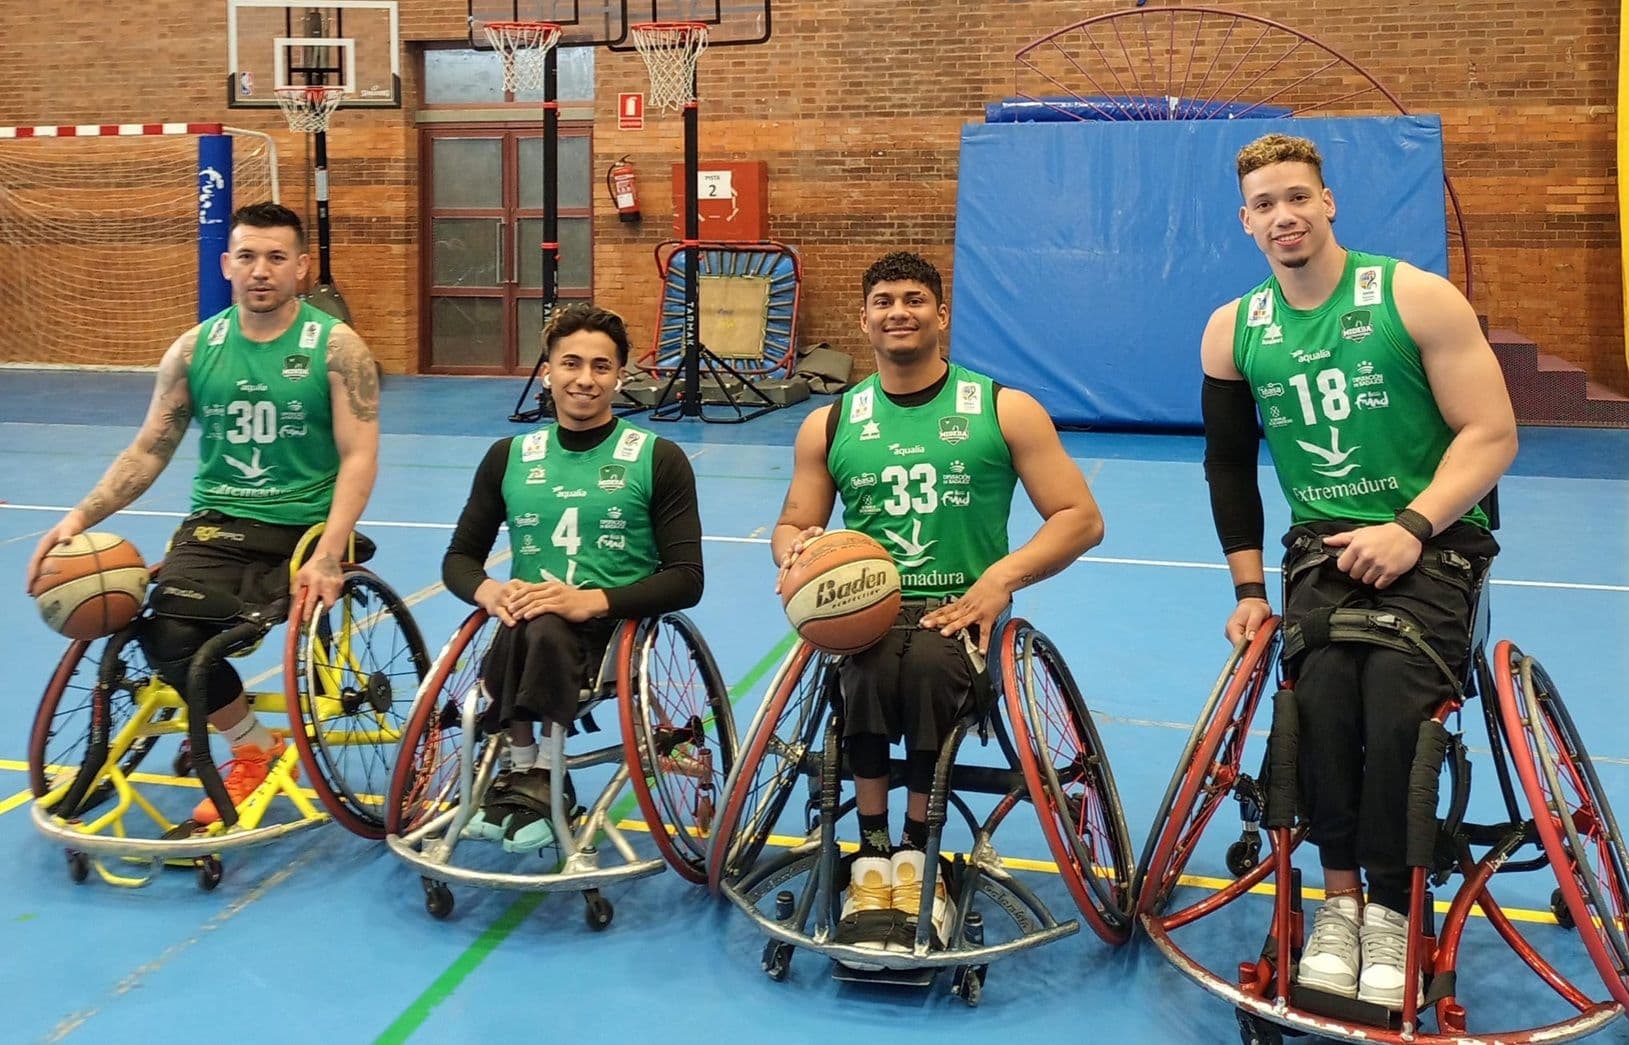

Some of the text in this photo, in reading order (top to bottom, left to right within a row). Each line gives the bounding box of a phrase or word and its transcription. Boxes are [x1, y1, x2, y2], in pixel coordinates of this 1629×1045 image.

[709, 185, 717, 197] 2
[686, 302, 695, 346] TARMAK
[1298, 349, 1331, 363] aqualia
[1288, 368, 1351, 426] 18
[226, 400, 277, 444] 30
[894, 444, 925, 456] aqualia
[881, 463, 938, 516] 33
[551, 507, 581, 555] 4
[816, 567, 887, 609] Baden
[902, 570, 965, 586] madura
